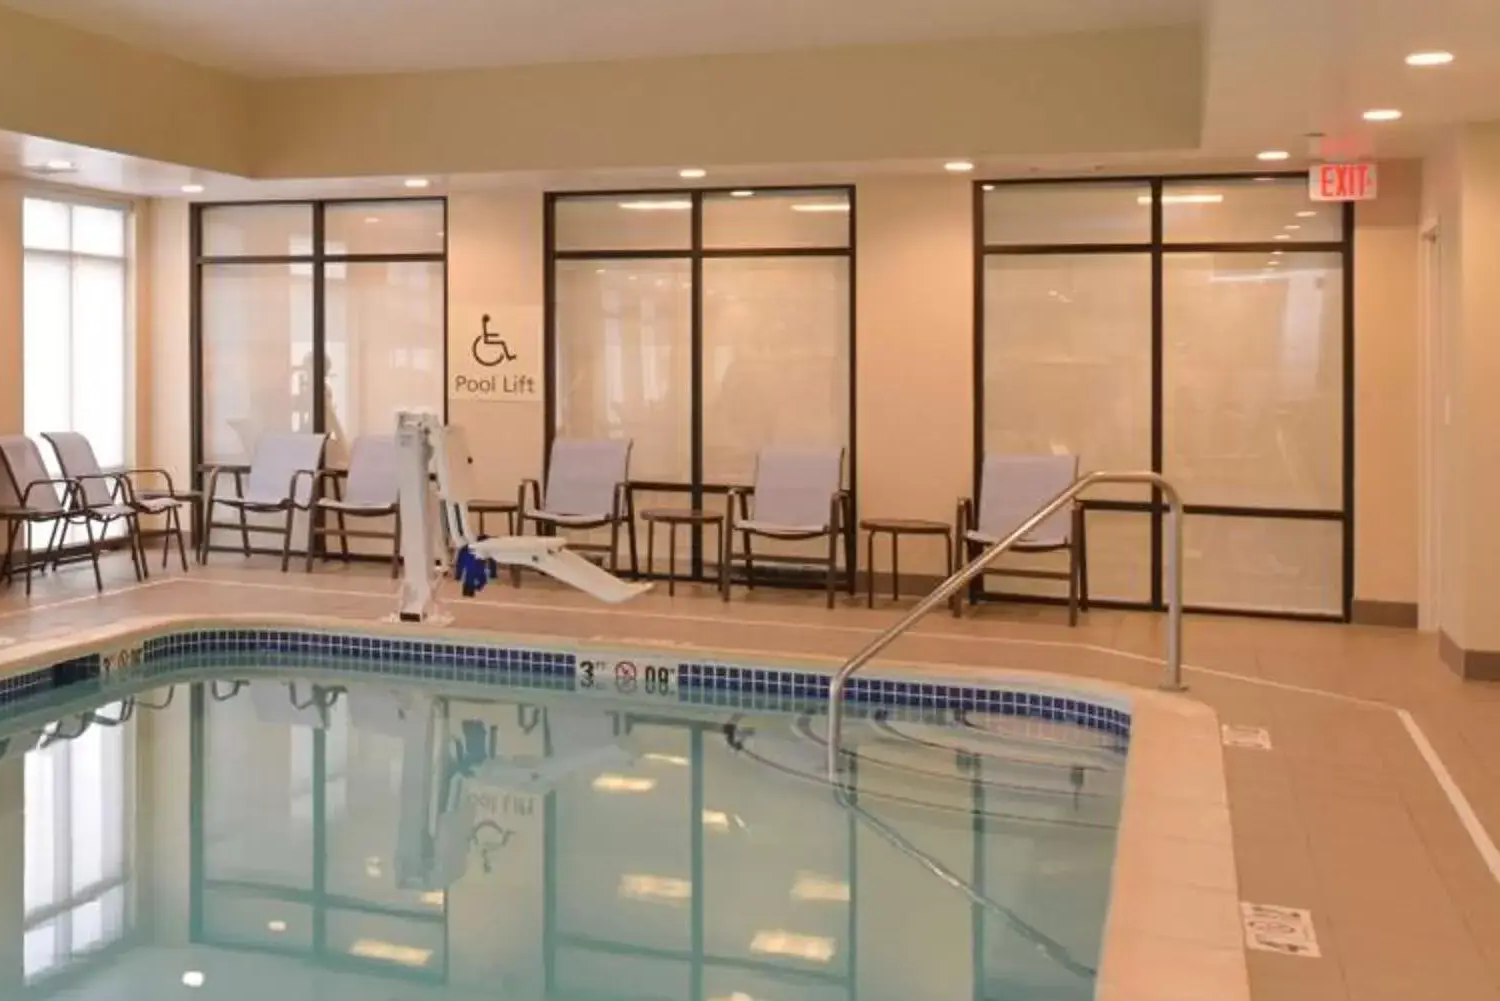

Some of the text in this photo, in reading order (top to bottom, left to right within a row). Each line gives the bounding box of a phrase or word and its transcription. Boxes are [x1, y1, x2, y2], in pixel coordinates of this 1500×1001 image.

[1321, 164, 1368, 197] EXIT
[455, 374, 534, 394] Pool Lift
